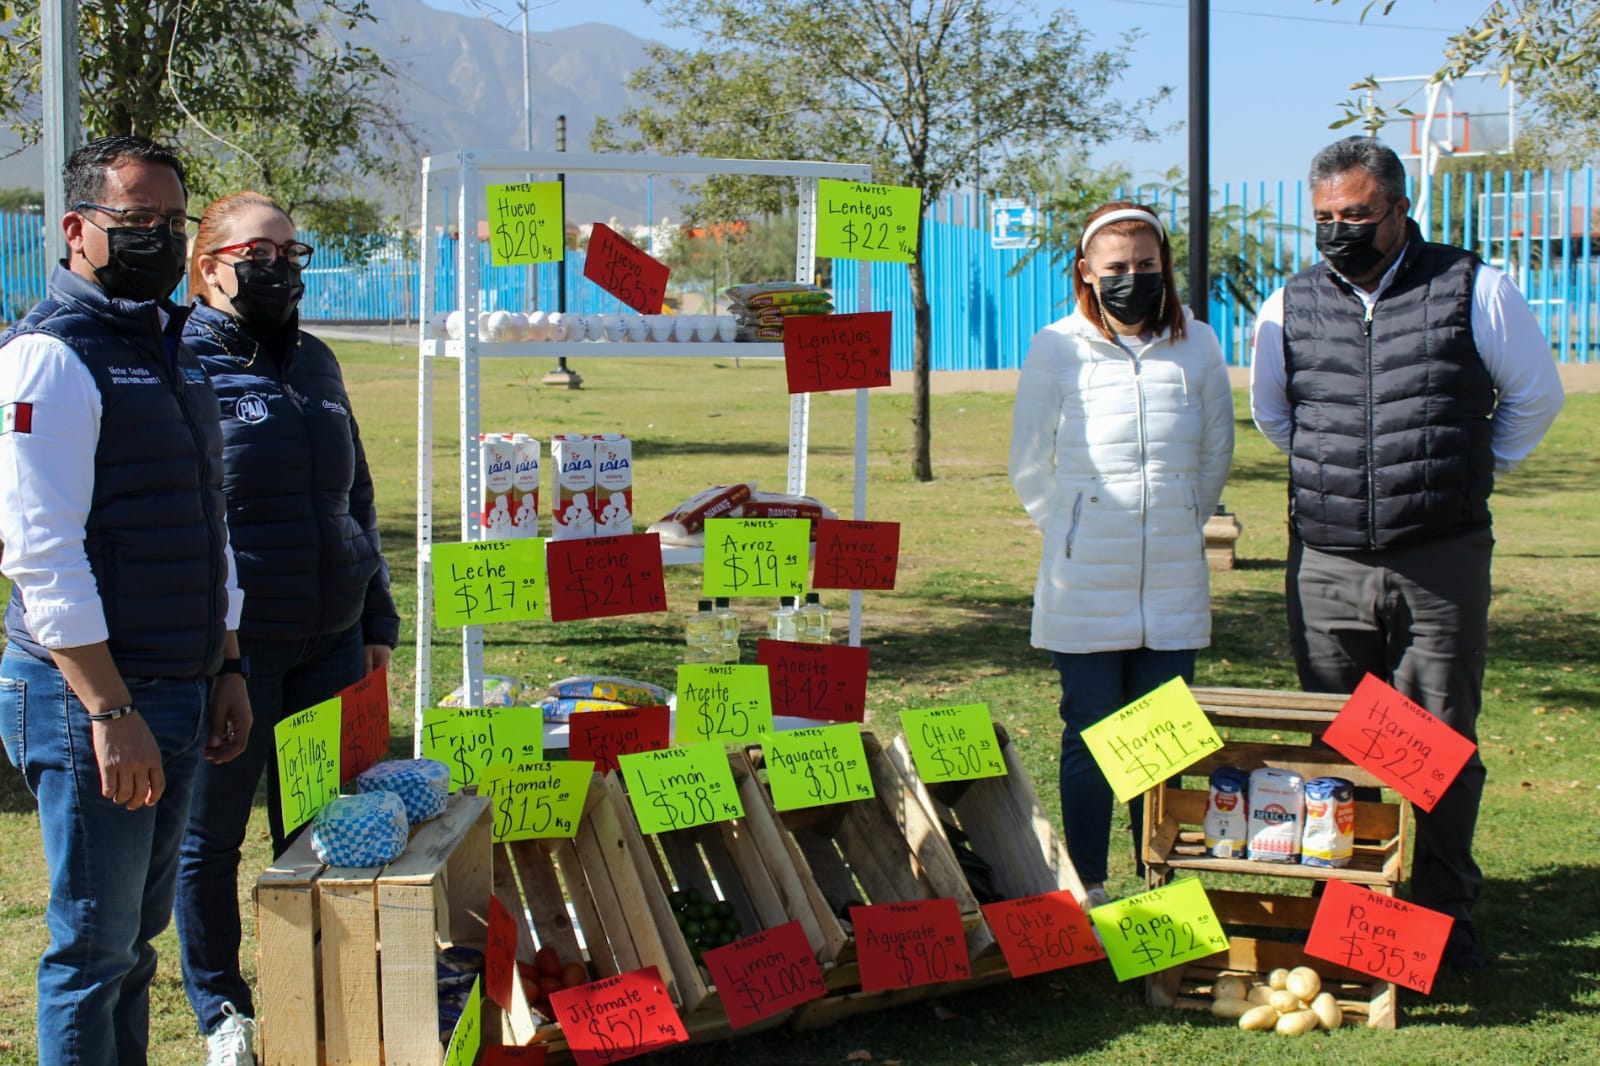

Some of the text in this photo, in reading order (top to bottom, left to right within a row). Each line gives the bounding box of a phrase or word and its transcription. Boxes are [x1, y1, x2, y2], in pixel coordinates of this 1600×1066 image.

[497, 197, 536, 219] Huevo
[829, 199, 892, 220] Lentejas
[797, 328, 871, 348] Lentejas
[240, 401, 264, 419] PAN
[488, 461, 511, 475] LALA
[515, 460, 538, 473] LALA
[563, 459, 592, 473] LALA
[600, 459, 629, 472] LALA
[720, 534, 776, 554] Arroz
[829, 534, 877, 554] Arroz
[451, 558, 506, 582] Leche
[566, 551, 629, 574] Leche
[777, 656, 828, 676] Aceite
[683, 681, 729, 702] Aceite
[425, 720, 494, 752] Frijol
[583, 726, 638, 747] Frijol
[1368, 700, 1432, 758] Harina
[1107, 720, 1176, 760] Harina
[1199, 736, 1219, 749] Kg
[279, 736, 326, 783] Tortillas
[771, 741, 839, 775] Aguacate
[486, 775, 561, 797] Jitomate
[857, 783, 869, 795] Kg
[1423, 788, 1437, 806] Kg
[723, 803, 738, 815] Kg
[1255, 809, 1295, 823] SELECTA
[555, 817, 571, 832] Kg
[1117, 914, 1174, 941] Papa
[1346, 904, 1397, 940] Papa
[866, 924, 935, 953] Aguacate
[1208, 935, 1226, 949] Kg
[1408, 970, 1427, 993] Kg
[567, 989, 642, 1023] Jitomate
